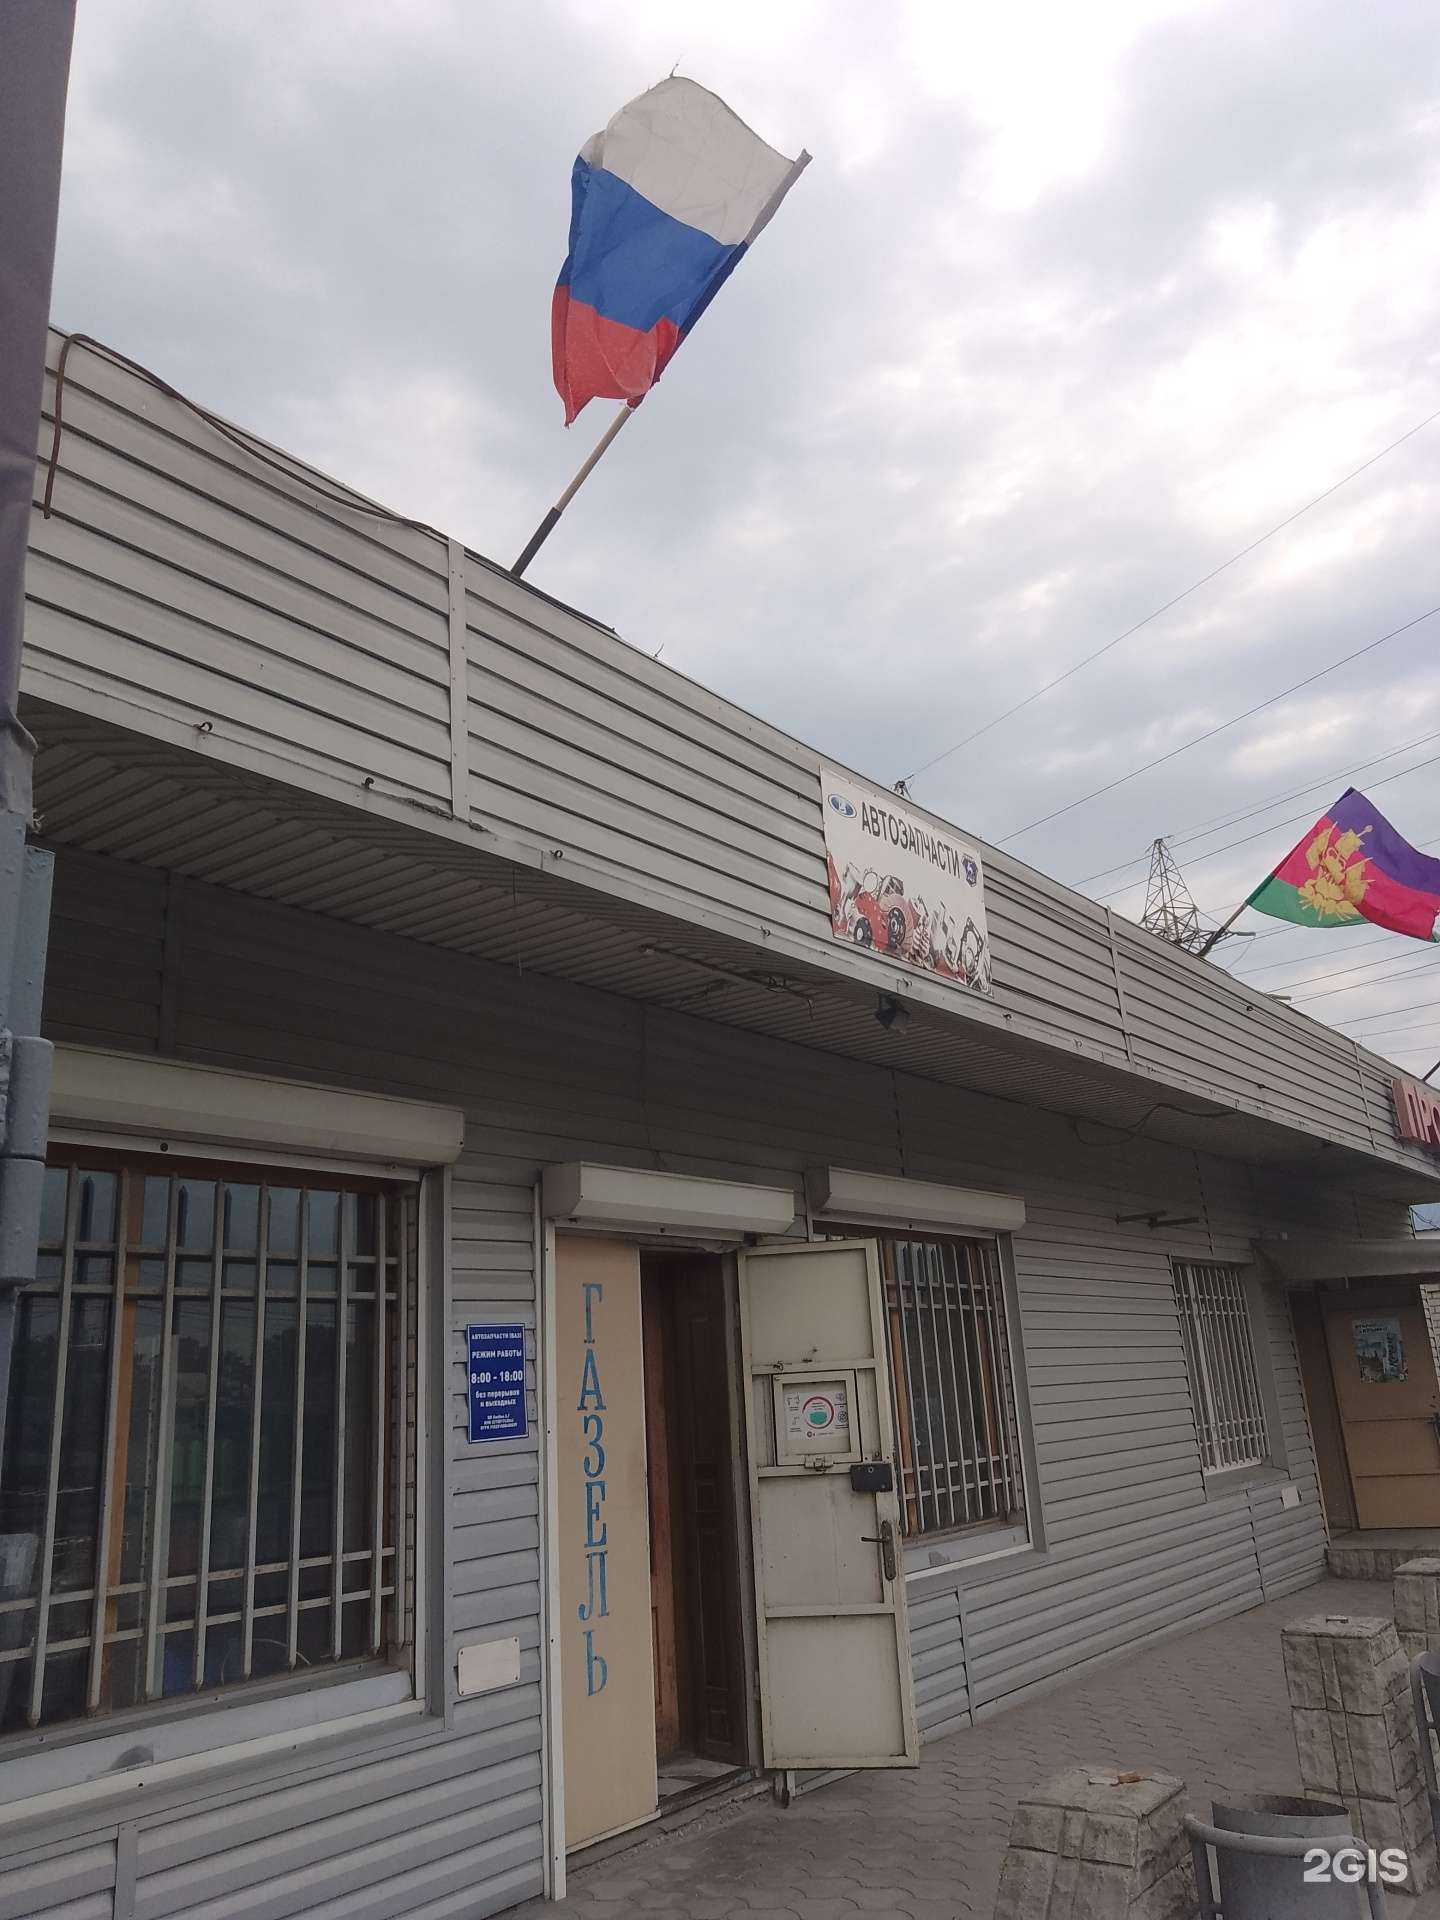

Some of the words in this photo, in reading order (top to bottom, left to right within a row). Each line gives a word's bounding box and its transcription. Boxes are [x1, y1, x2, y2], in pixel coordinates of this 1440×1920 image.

[861, 801, 961, 879] АВТОЗАПЧАСТИ
[471, 1350, 496, 1359] РЕЖИМ
[497, 1349, 522, 1358] РАБОТЫ
[471, 1372, 491, 1384] 8:00
[499, 1370, 523, 1382] 18:00
[475, 1390, 486, 1399] без
[485, 1399, 516, 1407] выходных
[576, 1283, 610, 1696] ГАЗЕЛЬ
